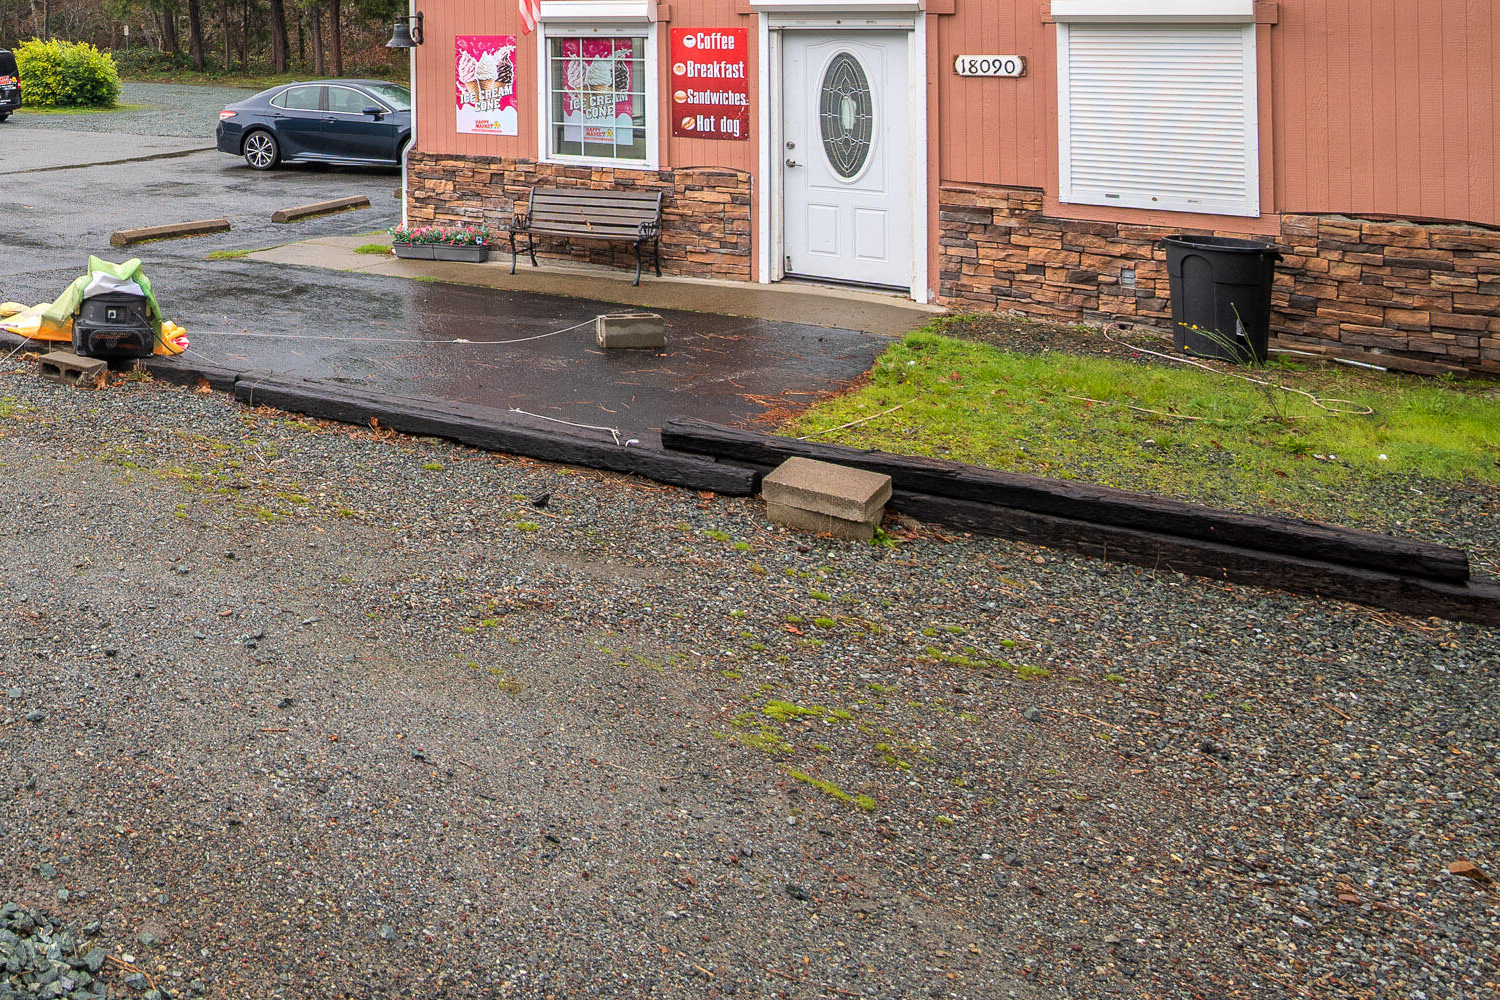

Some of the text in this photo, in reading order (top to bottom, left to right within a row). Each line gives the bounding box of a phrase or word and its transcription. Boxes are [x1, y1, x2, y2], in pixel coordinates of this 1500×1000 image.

[697, 32, 735, 50] Coffee
[687, 60, 745, 78] Breakfast
[961, 59, 1016, 74] 18090
[460, 83, 513, 104] ICE CREAM
[687, 88, 746, 105] Sandwiches
[474, 98, 501, 112] CONE
[569, 98, 586, 110] ICE
[585, 105, 614, 119] CONE
[696, 114, 740, 137] Hot dog
